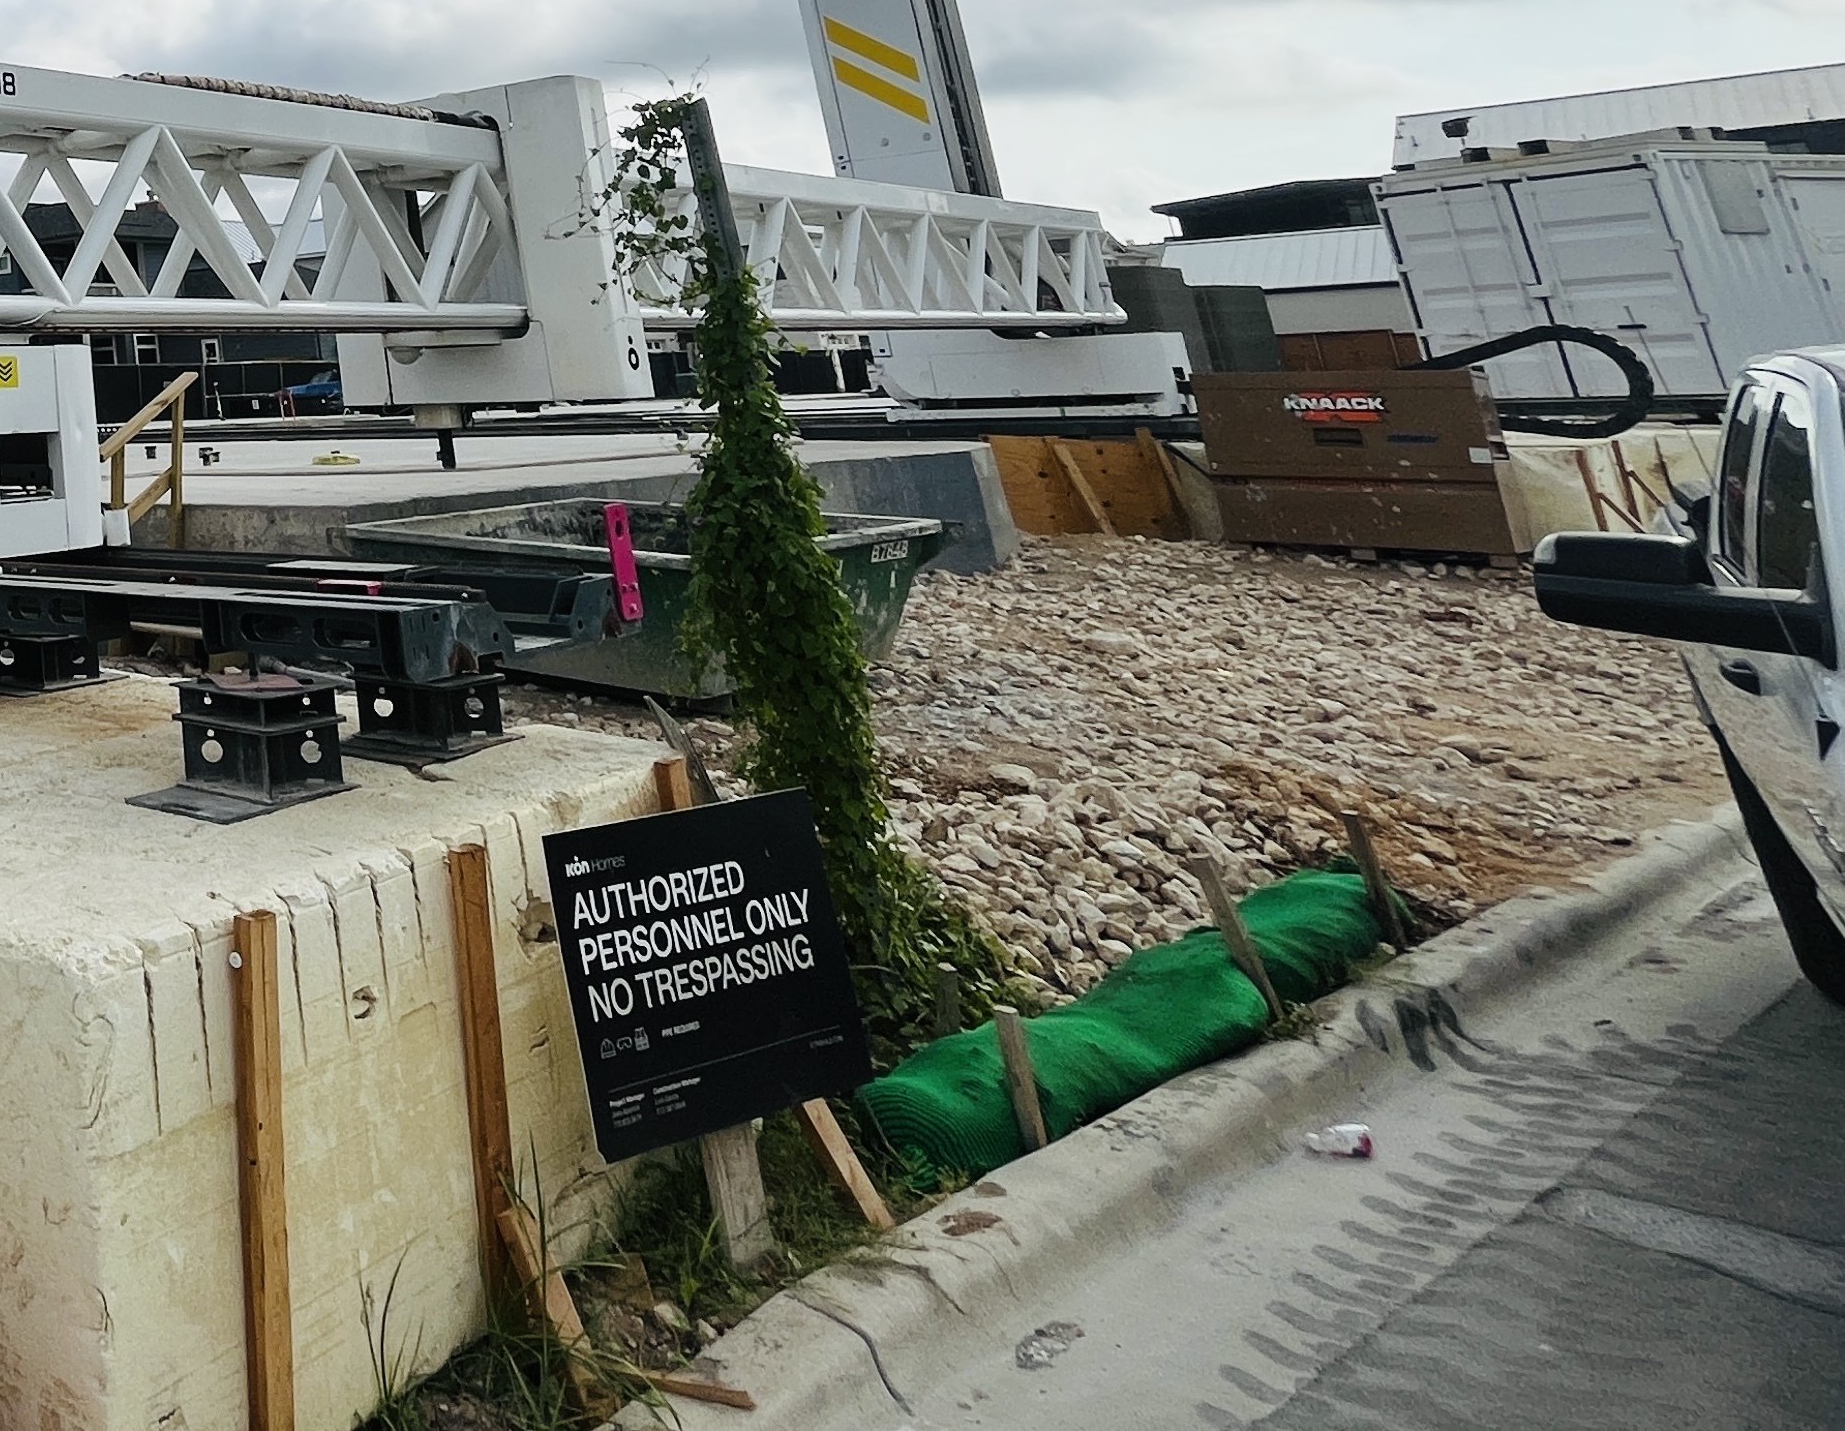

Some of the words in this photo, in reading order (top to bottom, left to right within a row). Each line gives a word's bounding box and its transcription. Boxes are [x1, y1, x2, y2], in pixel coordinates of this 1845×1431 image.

[1283, 396, 1385, 410] KNAACK
[573, 860, 745, 930] AUTHORIZED
[591, 855, 626, 873] Homes
[578, 906, 745, 976] PERSONNEL
[745, 888, 809, 936] ONLY
[587, 977, 634, 1023] NO
[634, 934, 815, 1009] TRESPASSING
